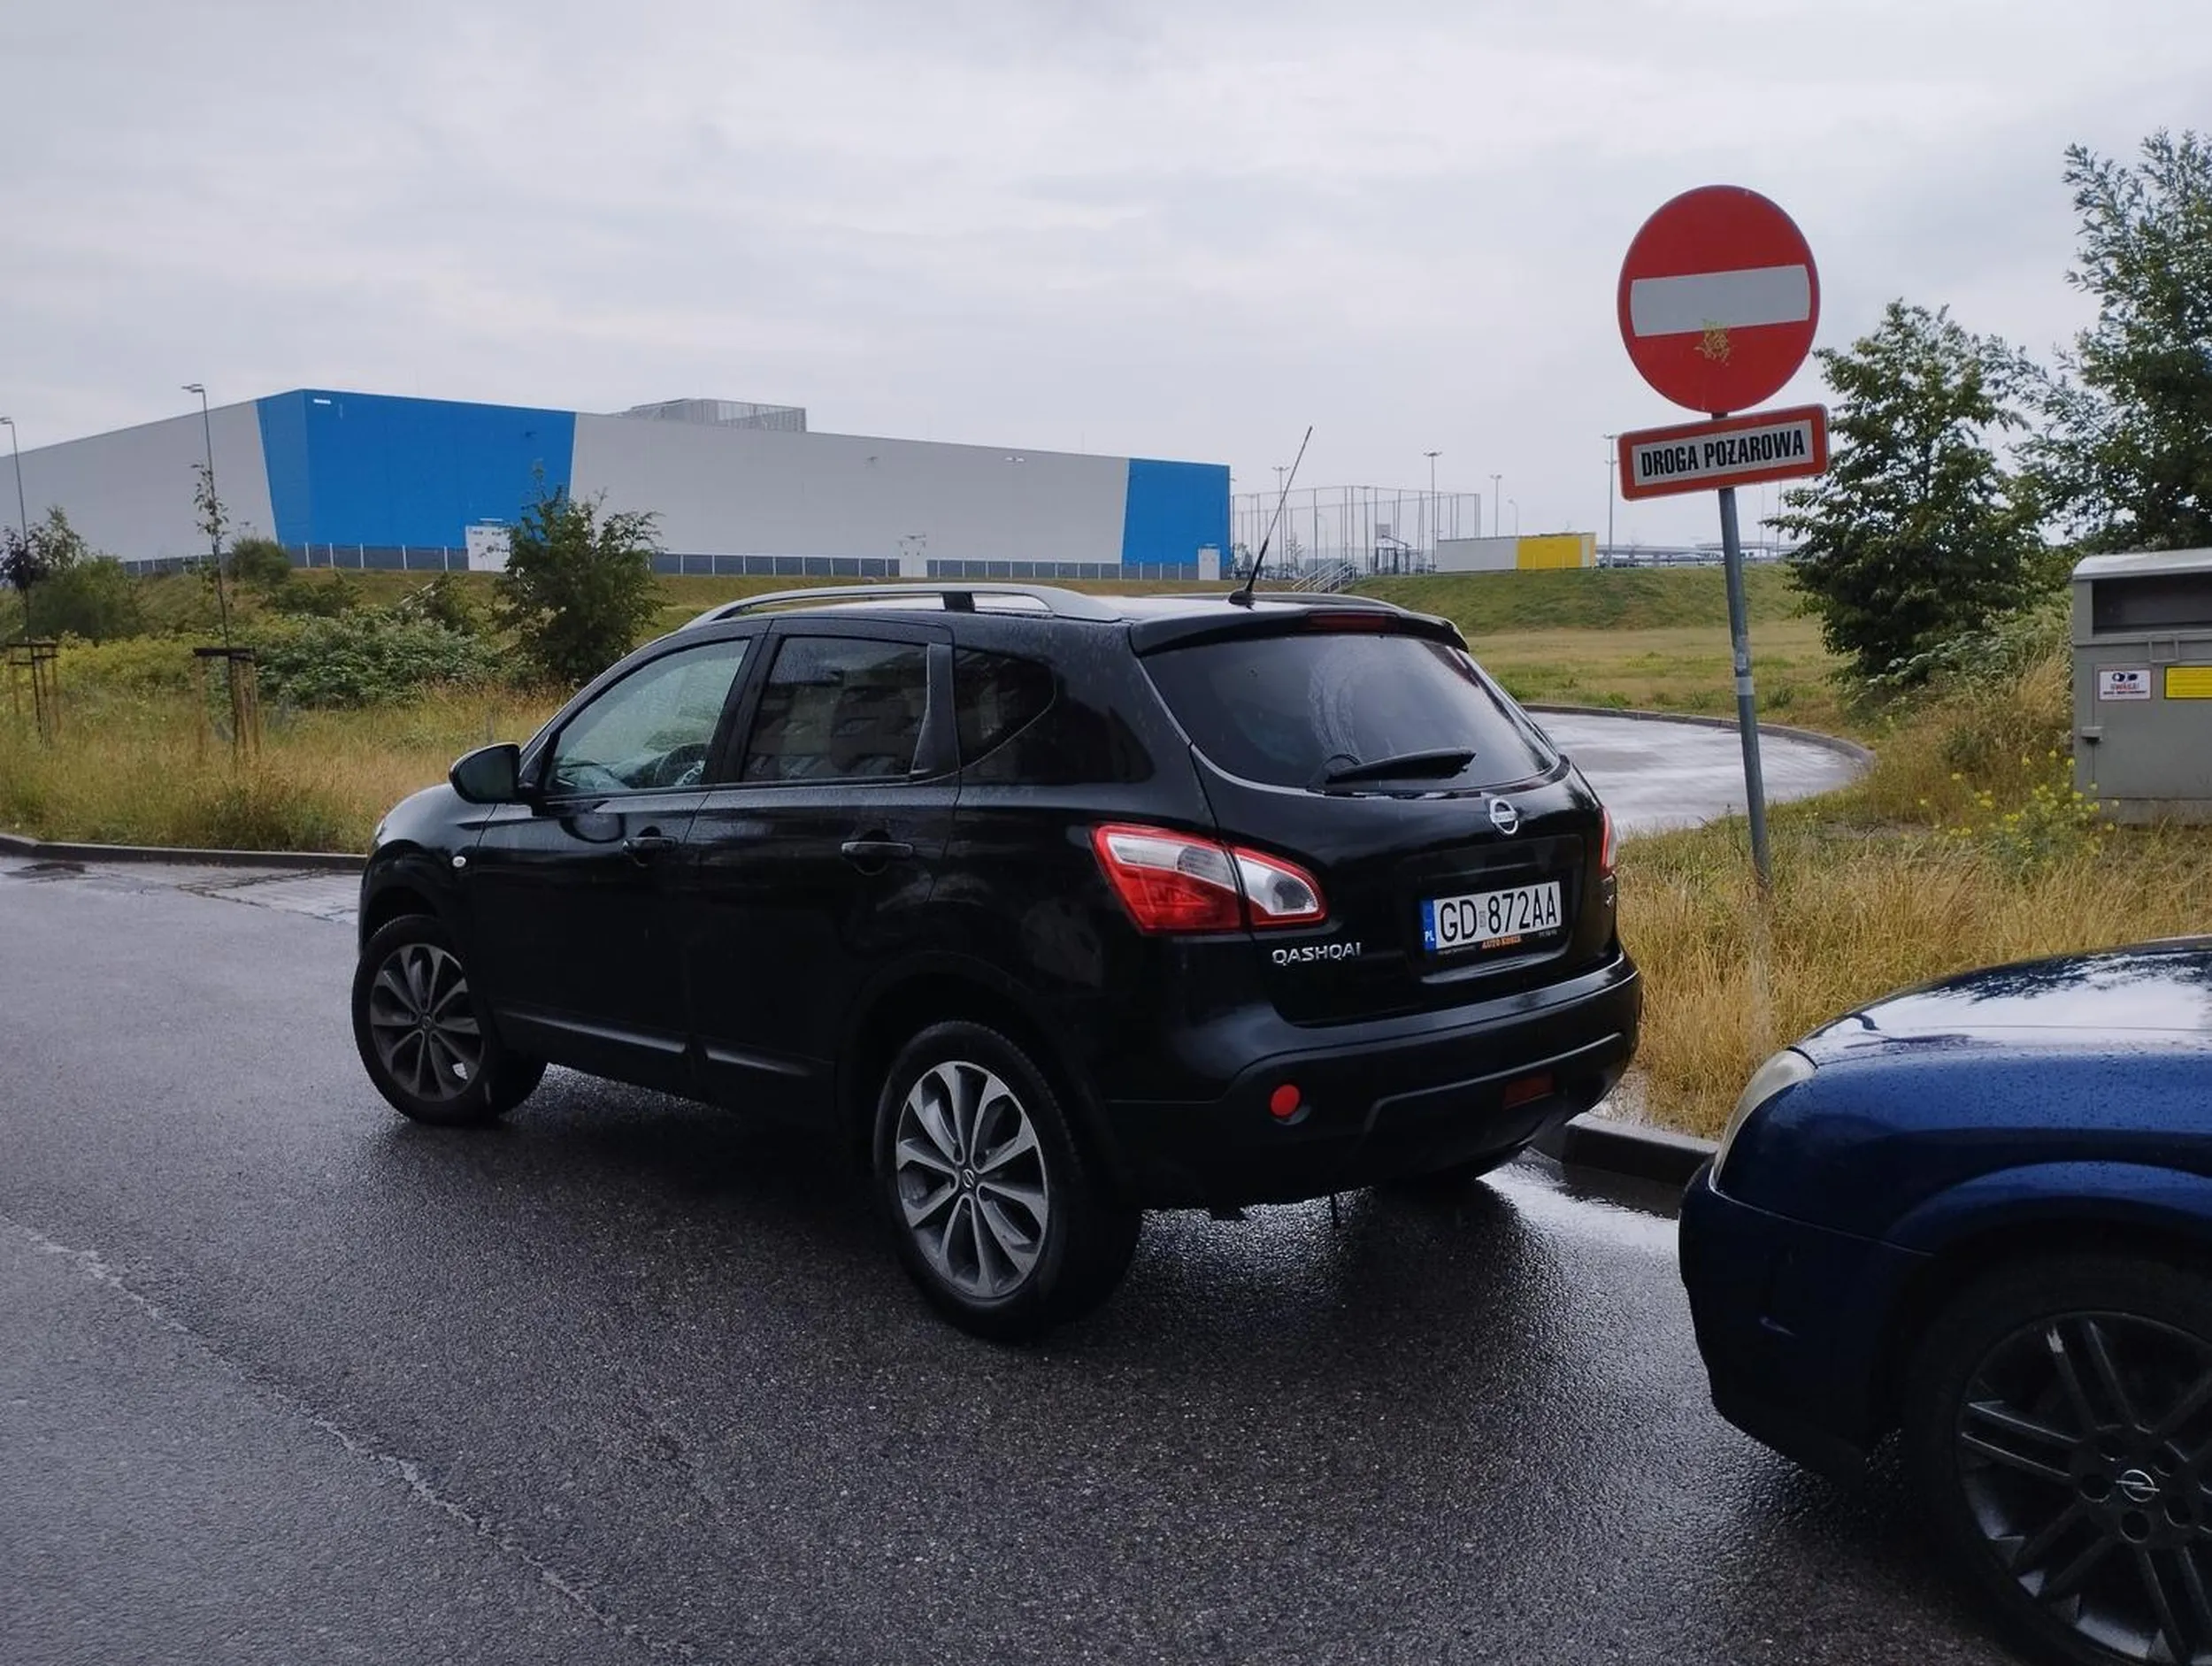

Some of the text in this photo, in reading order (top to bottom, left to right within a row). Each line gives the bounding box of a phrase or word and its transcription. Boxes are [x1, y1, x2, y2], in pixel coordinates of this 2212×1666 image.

[1641, 446, 1699, 477] DROGA
[1440, 886, 1557, 942] GD 872AA
[1425, 930, 1435, 942] PL
[1271, 942, 1362, 966] QASHQAI
